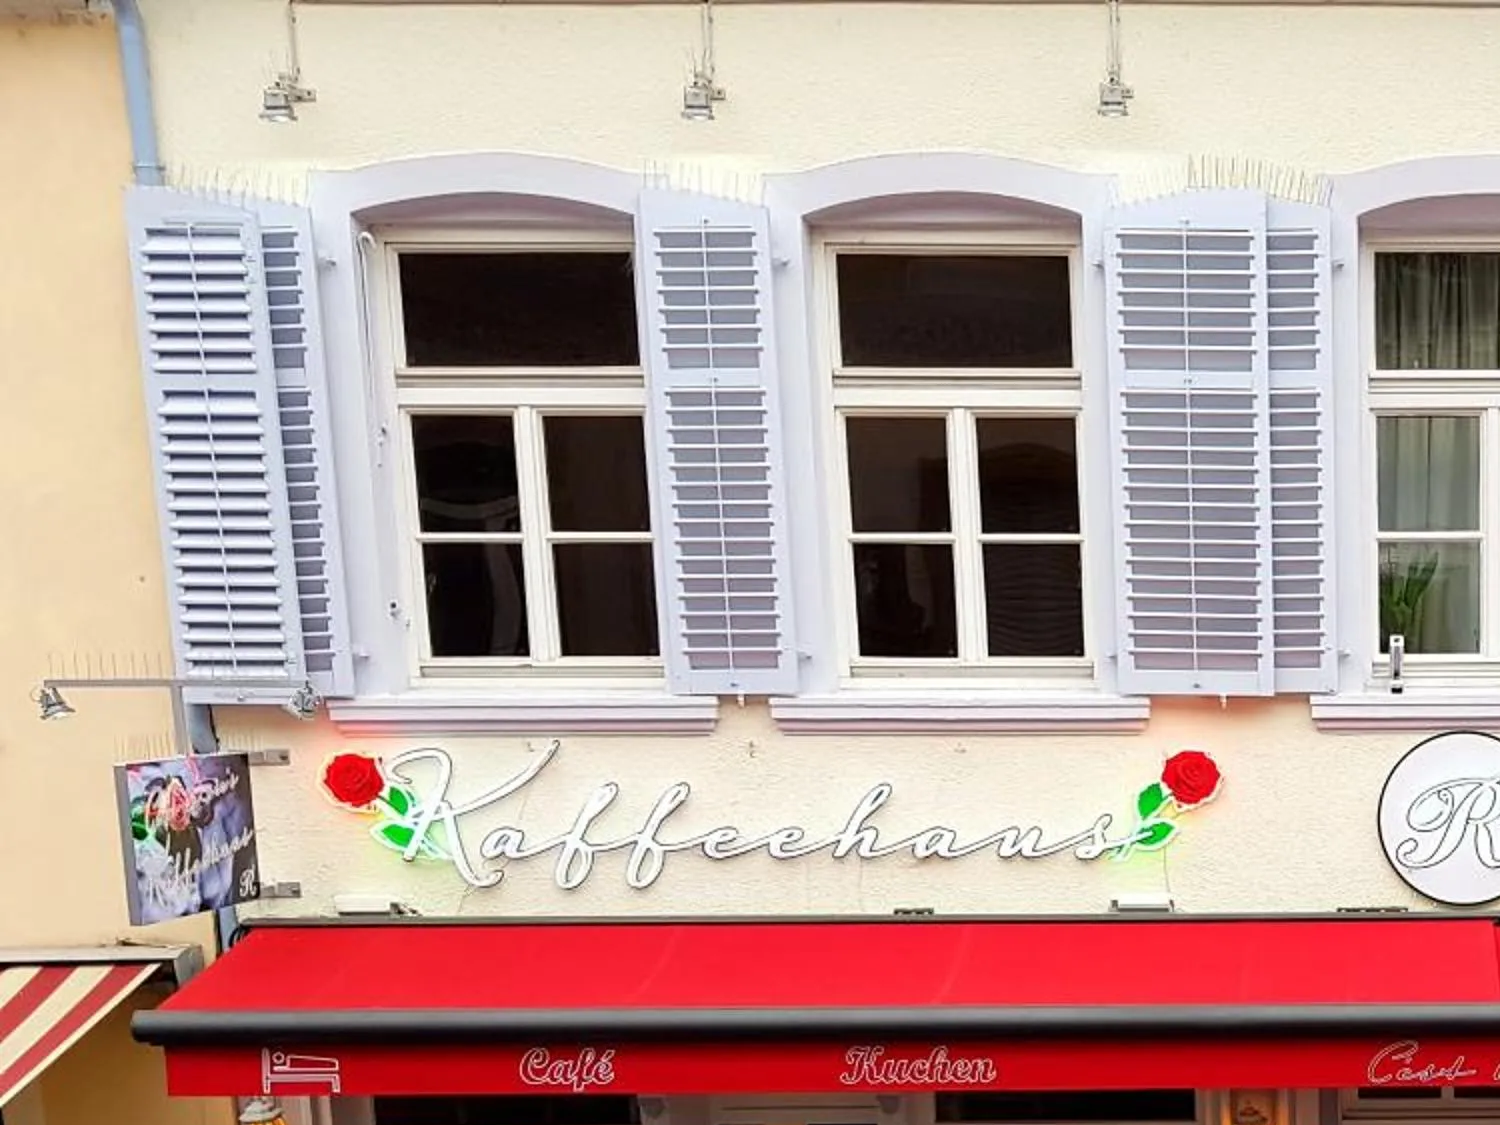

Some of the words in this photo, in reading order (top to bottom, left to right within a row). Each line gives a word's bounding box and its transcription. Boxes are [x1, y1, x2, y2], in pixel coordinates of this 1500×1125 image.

[385, 739, 1153, 890] Kaffeehaus
[519, 1047, 615, 1090] Café
[839, 1045, 997, 1085] Kuchen
